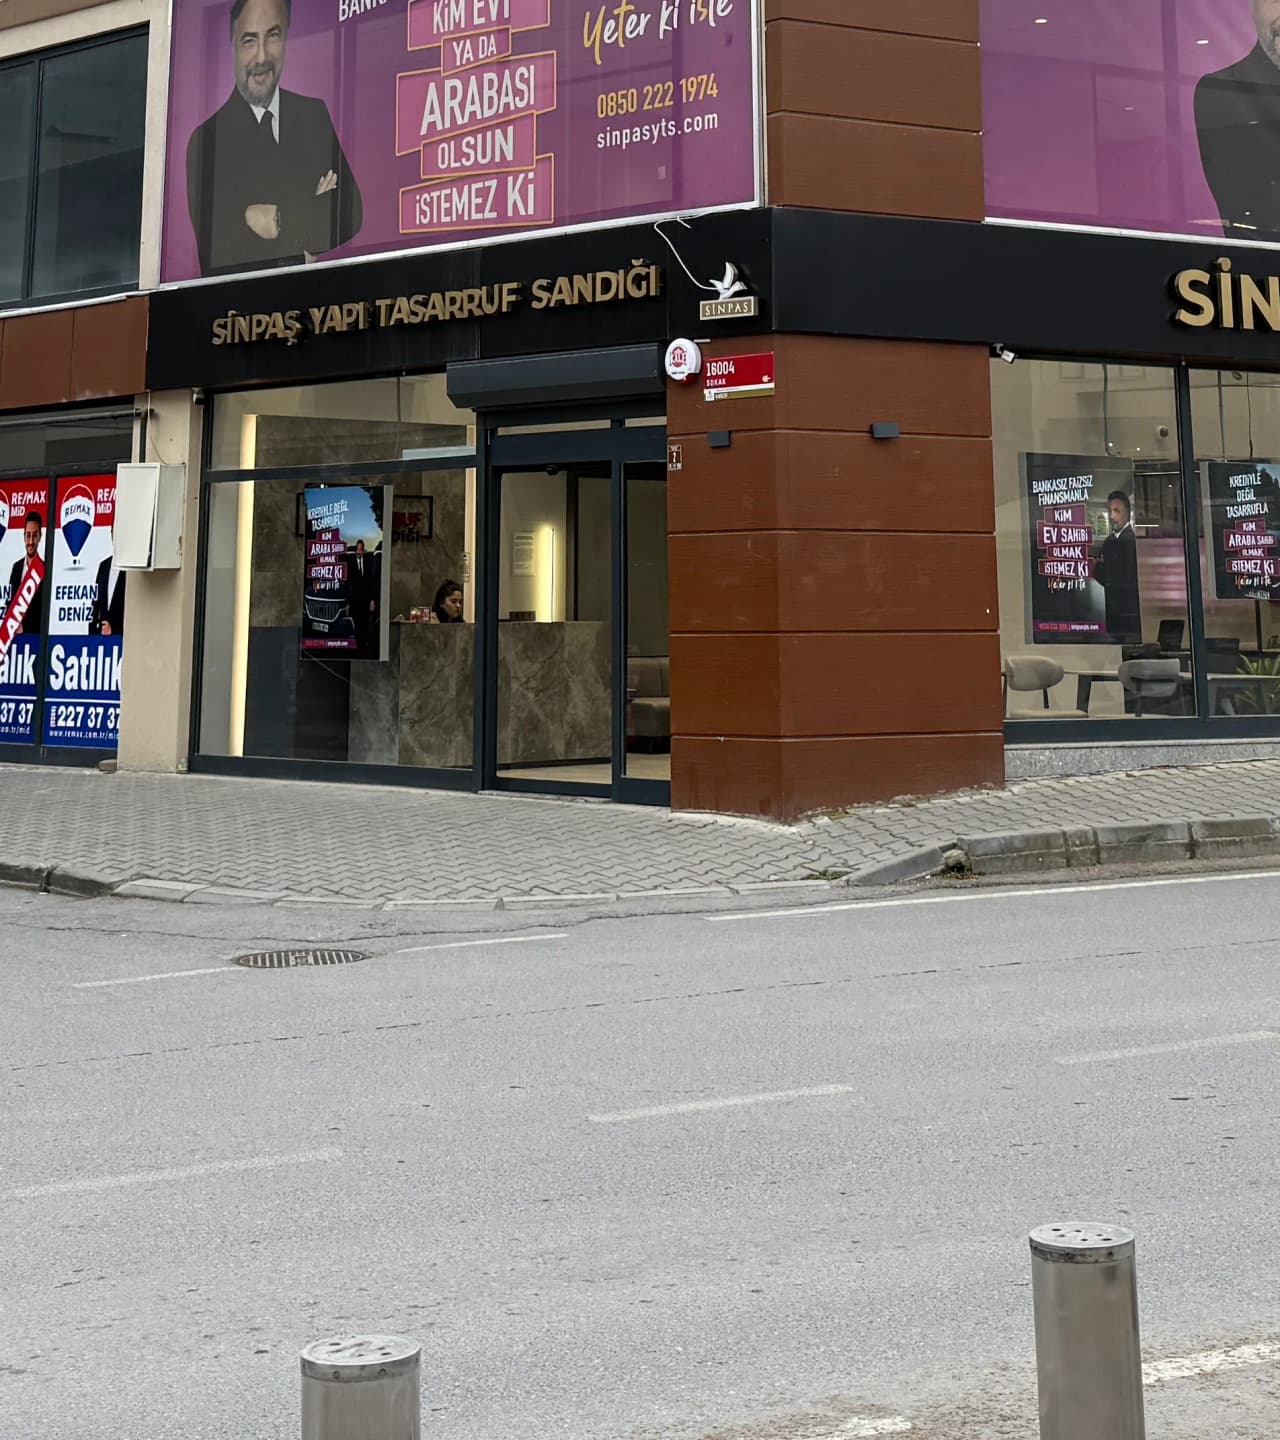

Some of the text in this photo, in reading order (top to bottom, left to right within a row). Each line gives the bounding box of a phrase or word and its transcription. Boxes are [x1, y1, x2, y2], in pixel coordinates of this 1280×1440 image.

[452, 35, 497, 66] YA DA
[420, 64, 535, 135] ARABASI
[596, 73, 718, 118] 0850 222 1974
[596, 110, 719, 150] sinpasyts.com
[437, 126, 515, 170] OLSUN
[210, 259, 659, 347] SİNPAŞ YAPI TASARRUF SANDIĞI
[706, 361, 735, 377] 16004
[706, 378, 726, 388] SOKAK
[11, 490, 47, 505] RE/MAX
[64, 503, 91, 517] RE/MAX
[1225, 501, 1269, 519] TASARRUFLA
[1052, 545, 1083, 559] OLMAK
[55, 583, 99, 602] EFEKAN
[58, 601, 94, 623] DENİZ
[49, 643, 123, 691] Satılık
[57, 705, 85, 728] 227
[87, 706, 105, 729] 37
